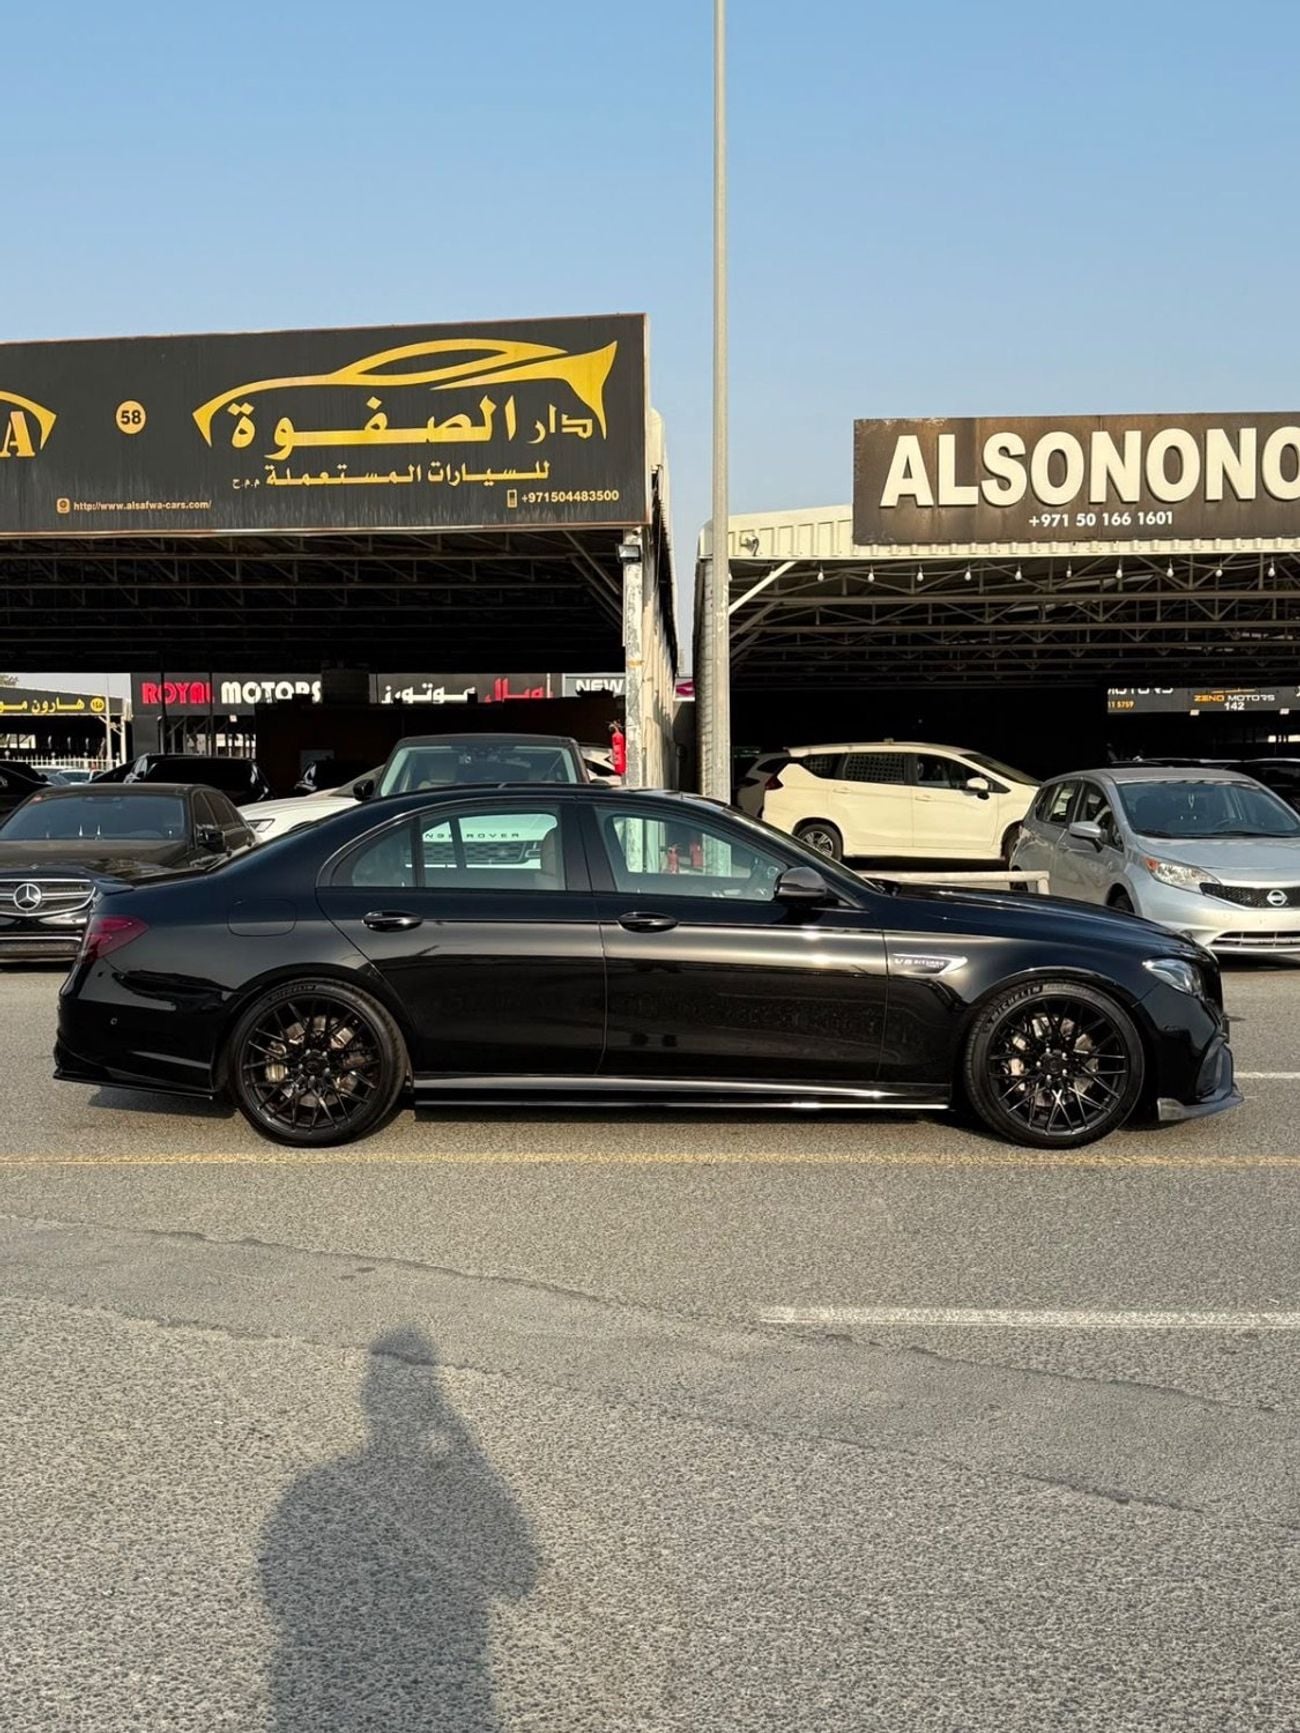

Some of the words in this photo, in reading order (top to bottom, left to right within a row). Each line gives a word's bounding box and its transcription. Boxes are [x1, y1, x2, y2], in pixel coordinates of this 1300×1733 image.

[120, 410, 142, 425] 58
[526, 404, 594, 445] دار
[226, 395, 517, 461] الصفوة
[264, 463, 422, 486] المستعملة
[427, 460, 551, 487] للسيارات
[521, 489, 620, 505] +971504483500
[1028, 513, 1069, 528] +971
[1076, 513, 1097, 527] 50
[1102, 512, 1132, 527] 166
[1138, 511, 1174, 525] 1601
[575, 679, 624, 694] NEW
[31, 696, 85, 713] هارون
[1194, 694, 1225, 702] ZENO
[1224, 702, 1245, 711] 142
